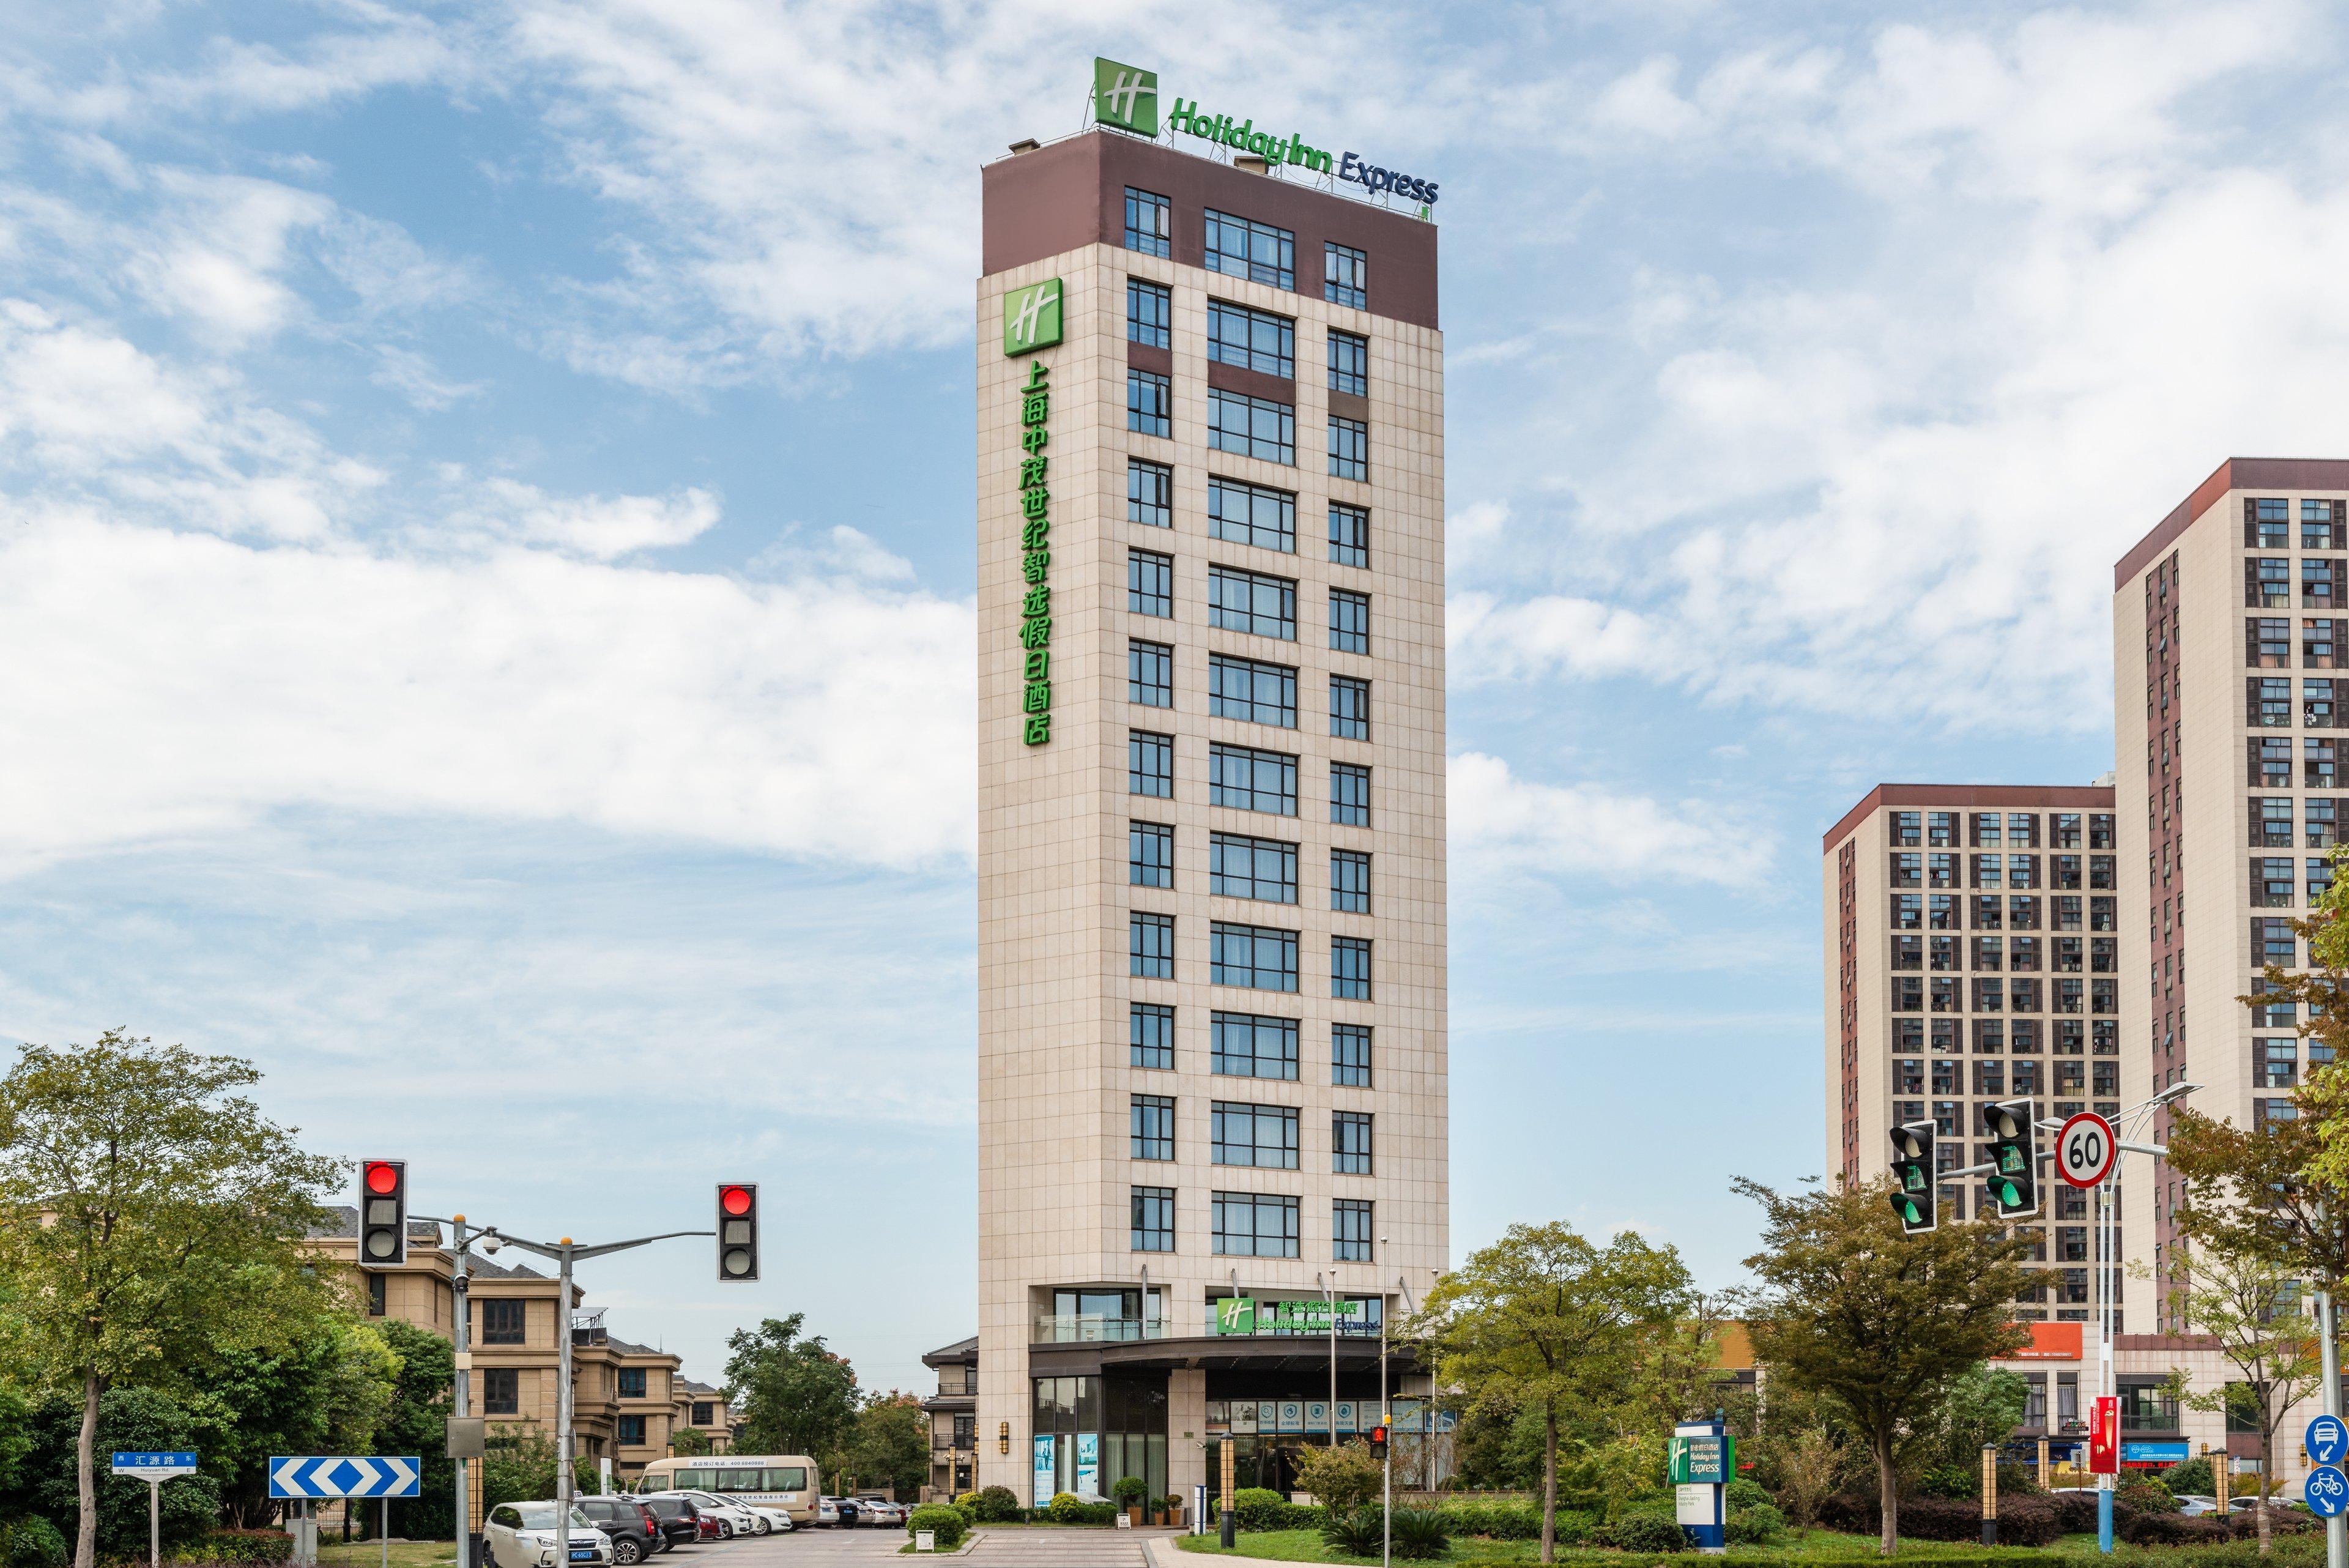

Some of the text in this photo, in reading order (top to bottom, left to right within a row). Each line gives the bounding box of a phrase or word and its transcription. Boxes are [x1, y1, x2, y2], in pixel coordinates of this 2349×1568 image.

[1338, 150, 1439, 205] Express
[1019, 359, 1052, 746] 上海中茂世纪智选假日酒店
[2069, 1132, 2101, 1169] 60
[1278, 1301, 1359, 1315] 智选假日酒店
[1335, 1318, 1378, 1332] Express
[135, 1455, 175, 1465] 汇源路
[1690, 1452, 1709, 1462] Holiday
[1690, 1462, 1720, 1475] Express
